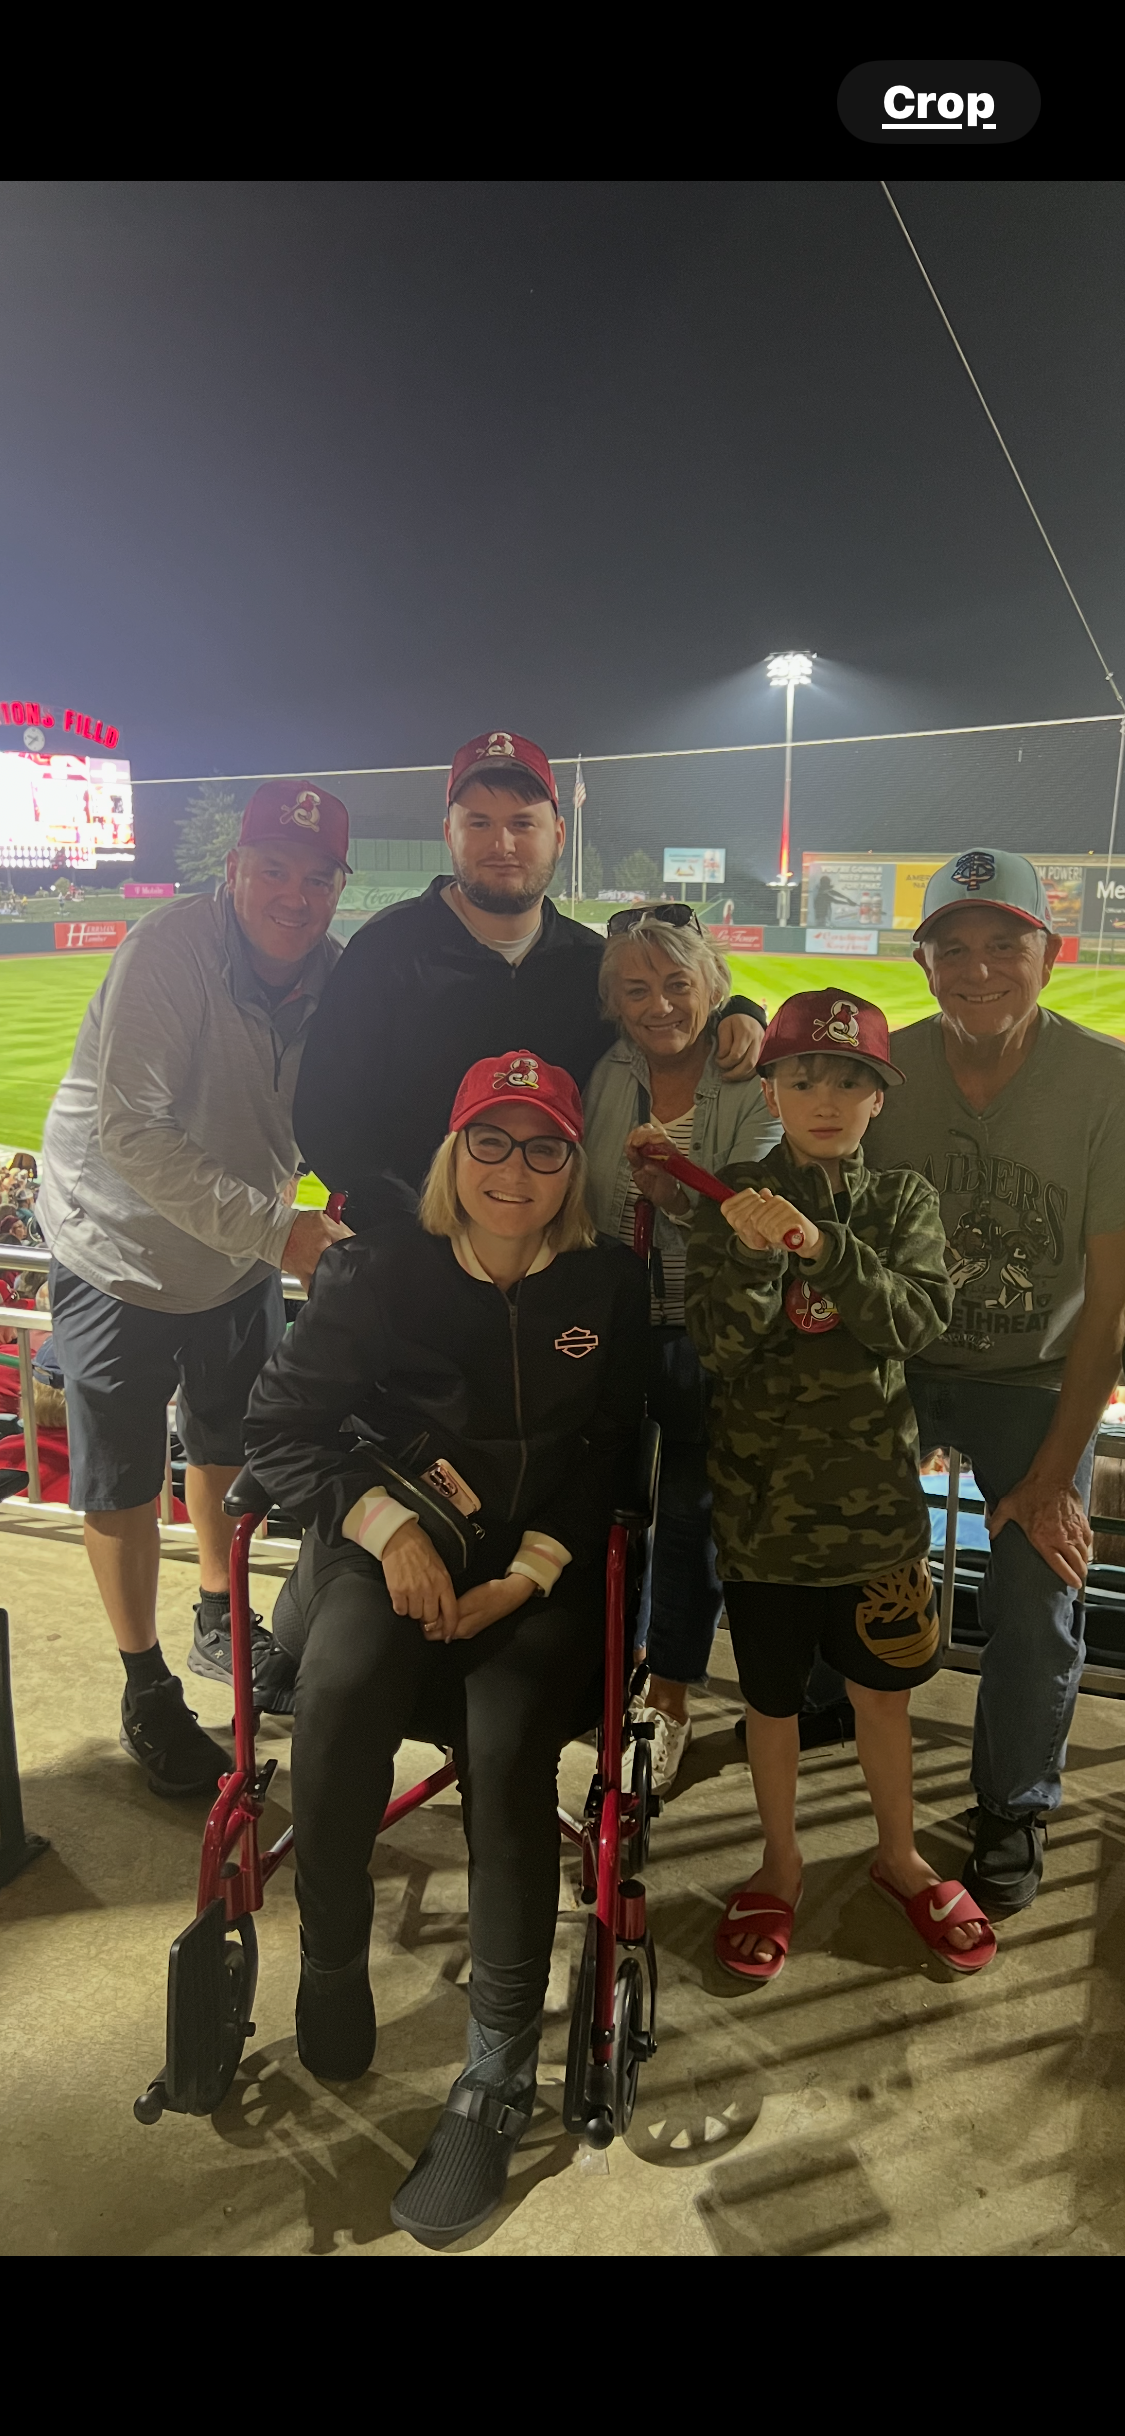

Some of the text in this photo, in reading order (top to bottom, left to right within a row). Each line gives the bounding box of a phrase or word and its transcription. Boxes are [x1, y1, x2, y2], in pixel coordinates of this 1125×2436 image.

[63, 708, 120, 749] FIELD
[1048, 866, 1083, 880] POWER!
[888, 1153, 1067, 1266] AIDERS
